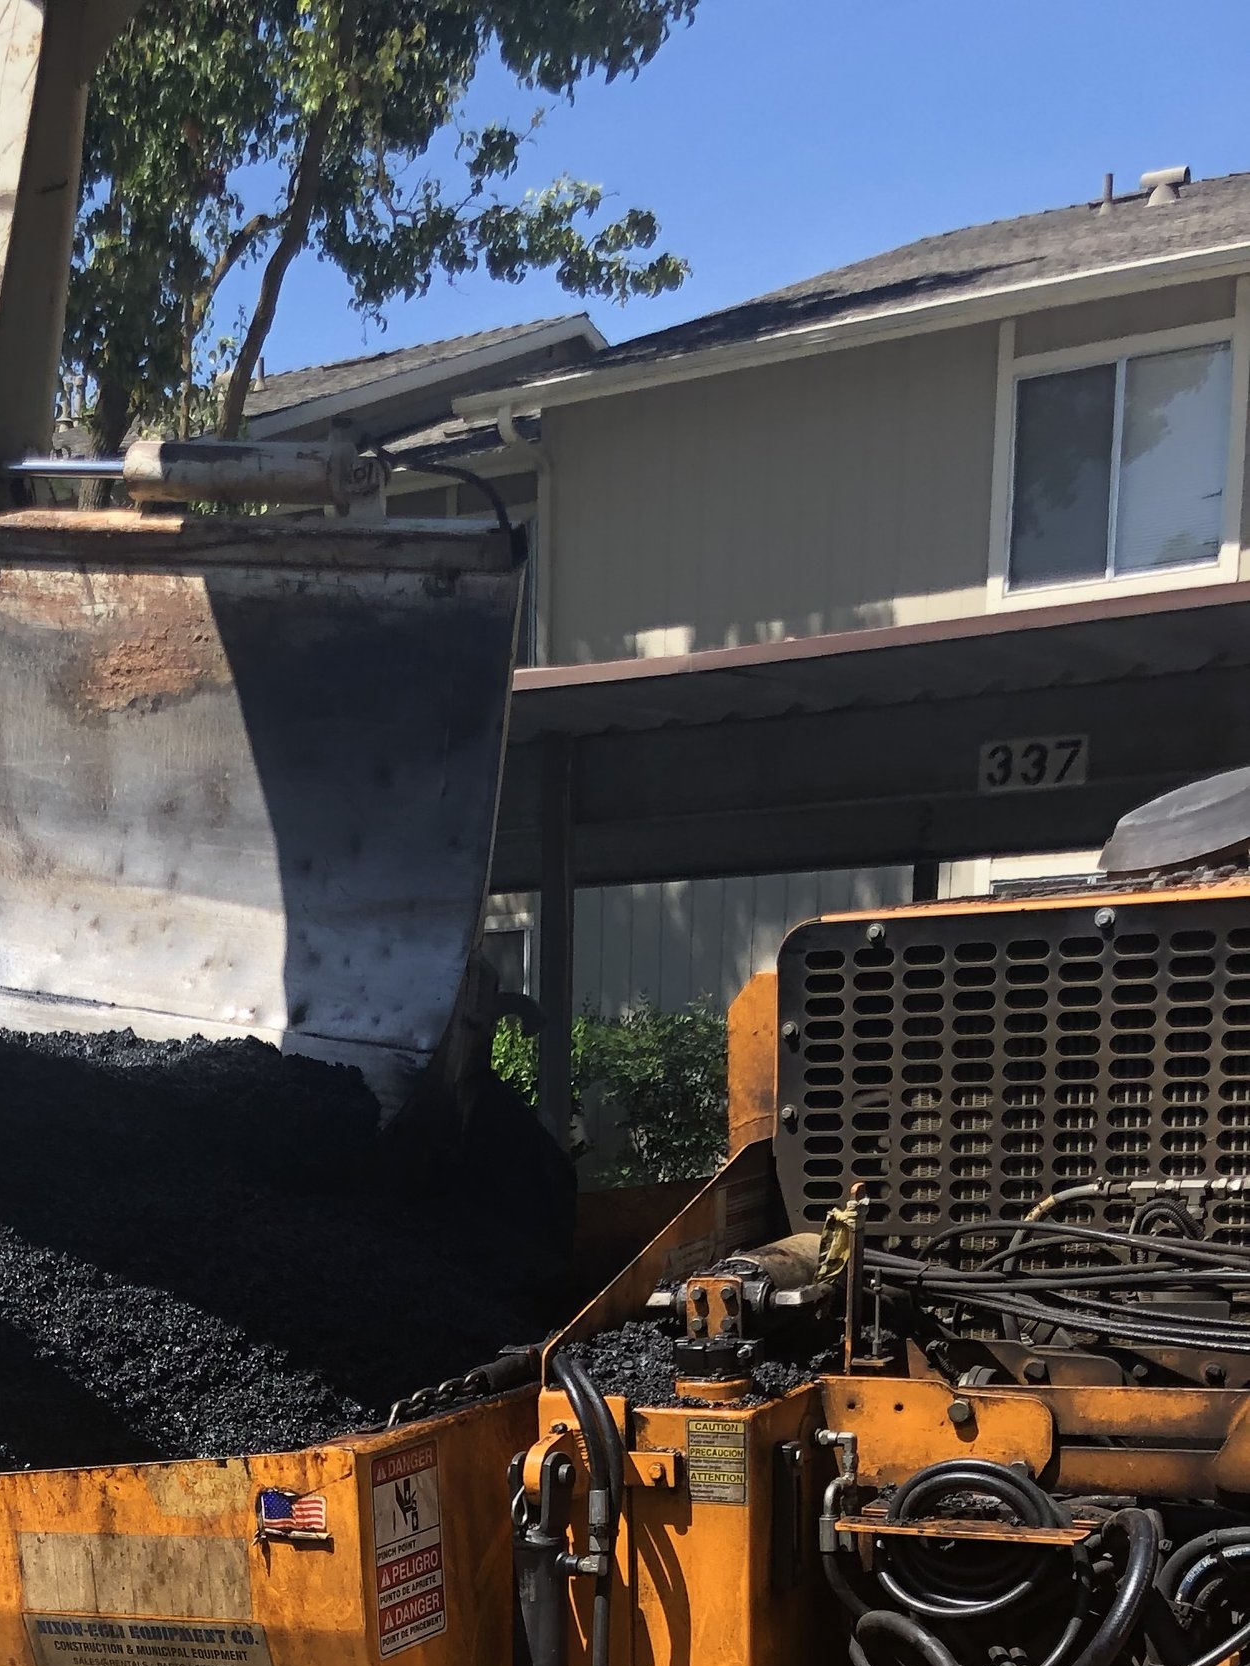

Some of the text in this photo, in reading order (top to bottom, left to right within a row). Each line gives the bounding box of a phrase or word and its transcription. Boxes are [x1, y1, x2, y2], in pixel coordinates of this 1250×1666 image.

[986, 739, 1082, 787] 337
[694, 1422, 738, 1432] CAUTION
[387, 1447, 433, 1477] DANGER
[690, 1448, 744, 1458] PRECAUCION
[690, 1472, 743, 1483] ATTENTION
[377, 1539, 416, 1563] PINCH POINT
[392, 1550, 438, 1583] PELIGRO
[379, 1574, 437, 1606] PUNTO DE APRIETE
[395, 1592, 440, 1625] DANGER
[129, 1625, 226, 1644] EQUIPMENT
[231, 1629, 259, 1645] CO.
[382, 1631, 400, 1647] POINT
[401, 1628, 409, 1639] DE
[54, 1640, 248, 1661] CONSTRUCTION & MUNICIPAL EQUIPMENT
[72, 1657, 101, 1666] SALES
